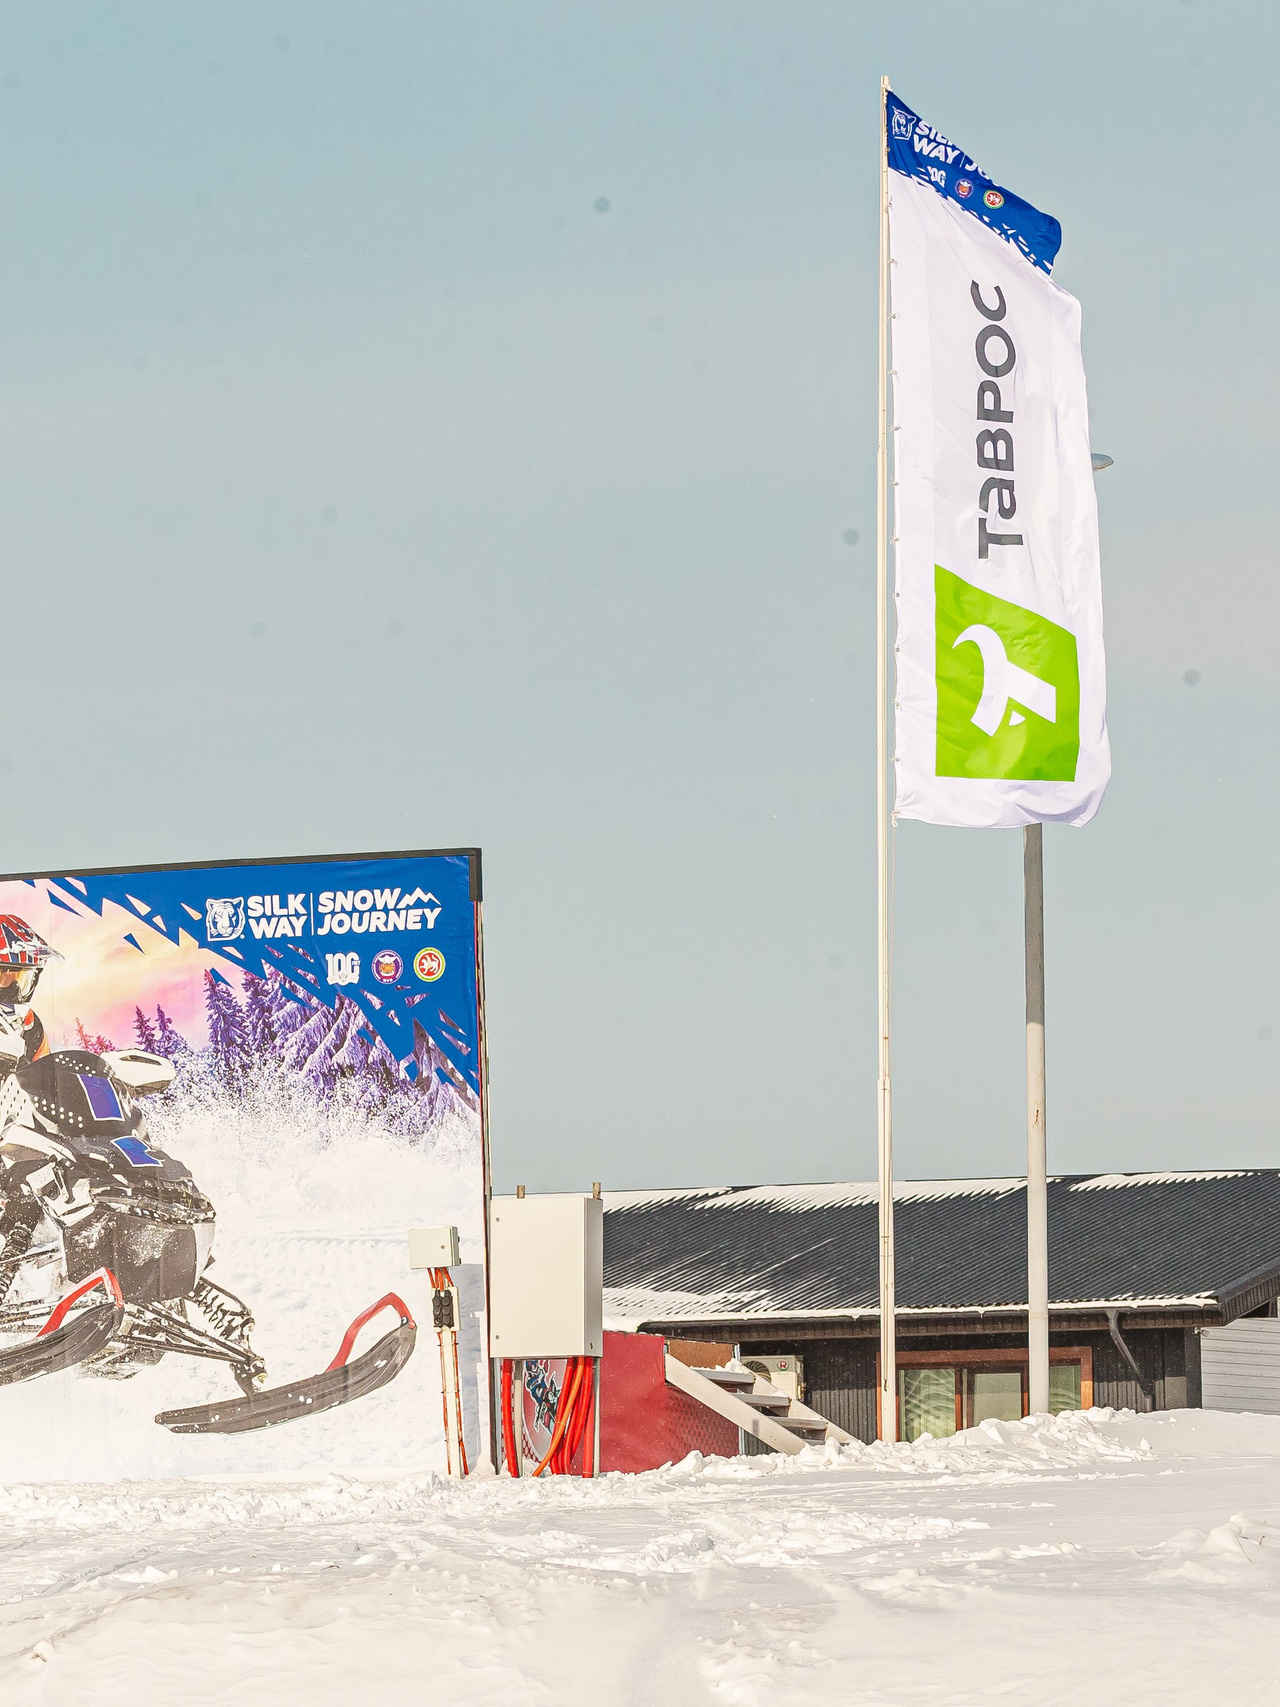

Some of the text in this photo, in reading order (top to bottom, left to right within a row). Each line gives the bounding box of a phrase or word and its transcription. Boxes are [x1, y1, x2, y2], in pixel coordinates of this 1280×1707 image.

[915, 120, 954, 146] SIL
[913, 134, 961, 165] WAY
[247, 887, 402, 918] SILK SNOW
[248, 907, 443, 939] WAY JOURNEY
